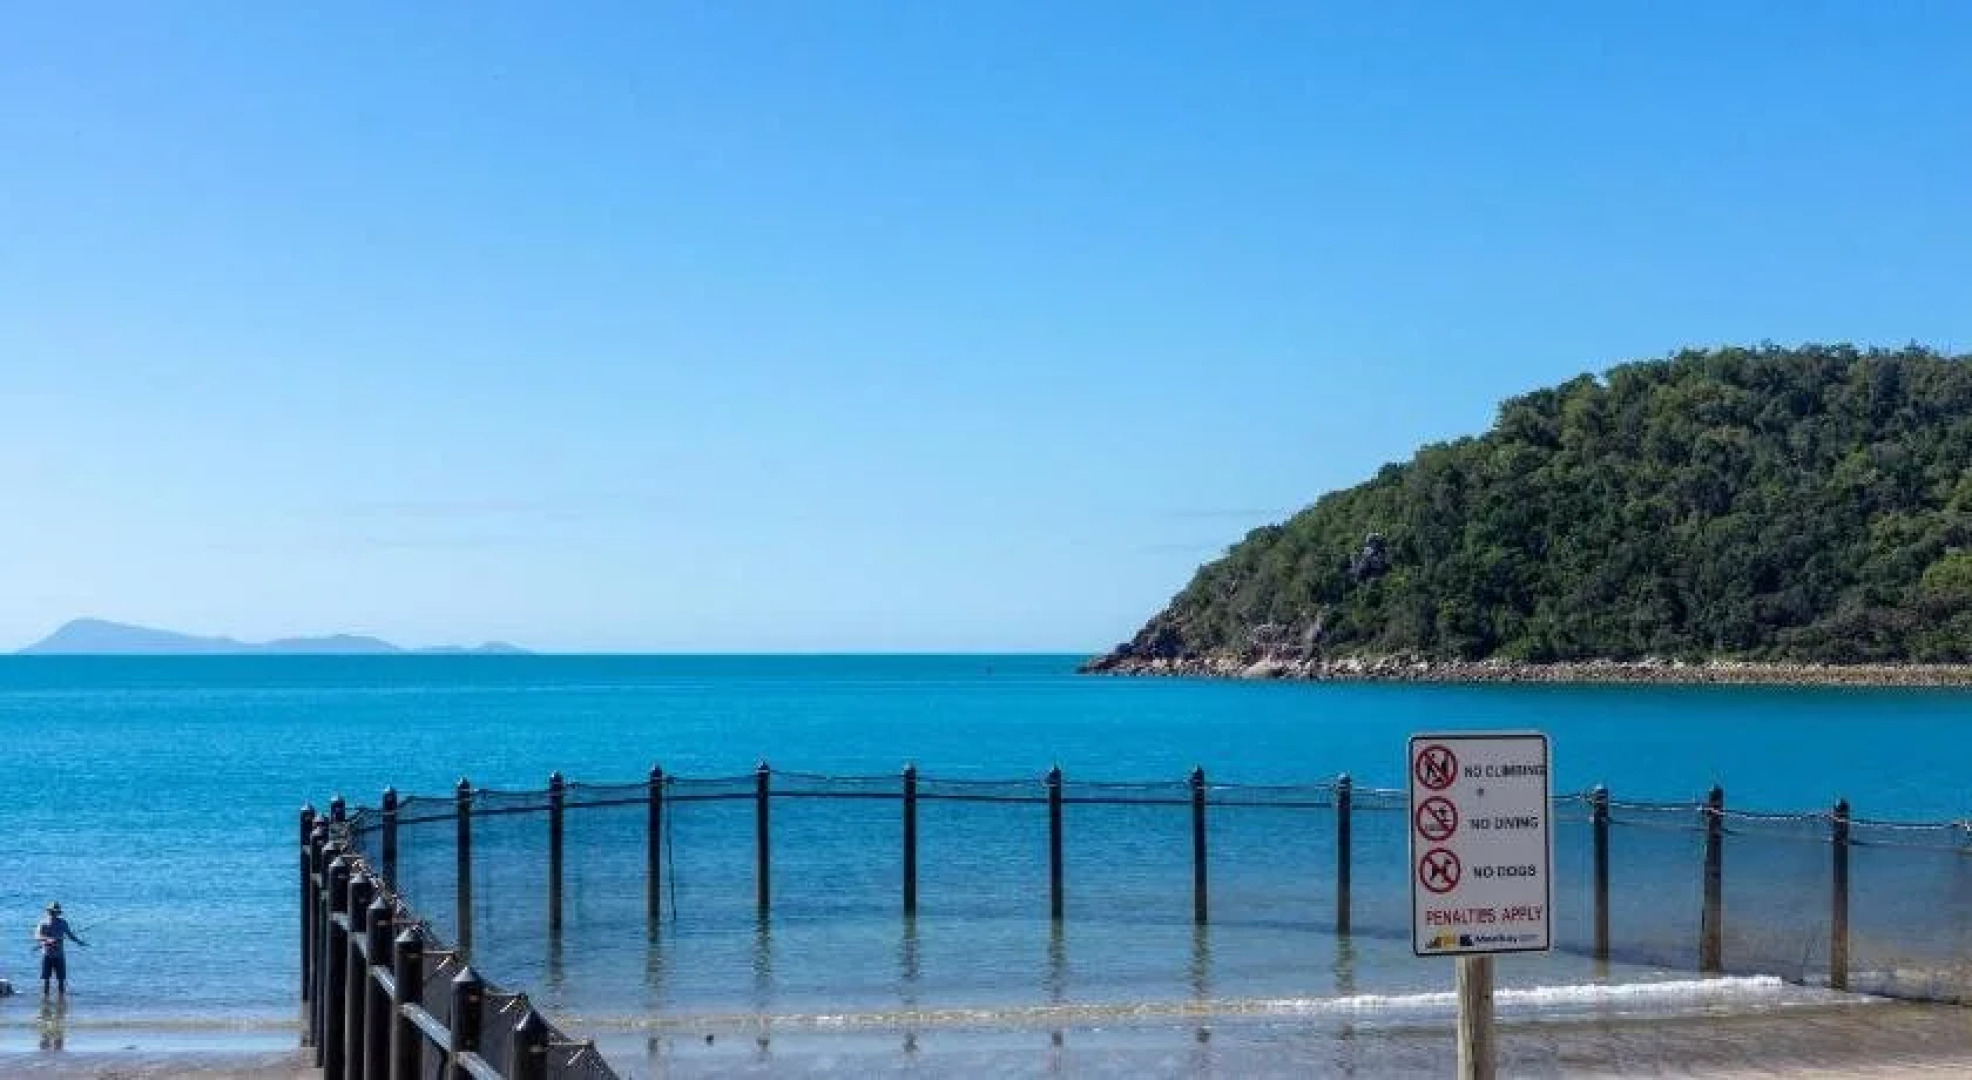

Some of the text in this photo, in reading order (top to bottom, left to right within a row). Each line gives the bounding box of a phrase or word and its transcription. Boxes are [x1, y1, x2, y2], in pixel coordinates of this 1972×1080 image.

[1464, 764, 1545, 778] NO CLIMBING
[1470, 816, 1538, 830] NO DIVING
[1473, 865, 1536, 878] NO DOGS
[1426, 904, 1542, 925] PENALTIES APPLY
